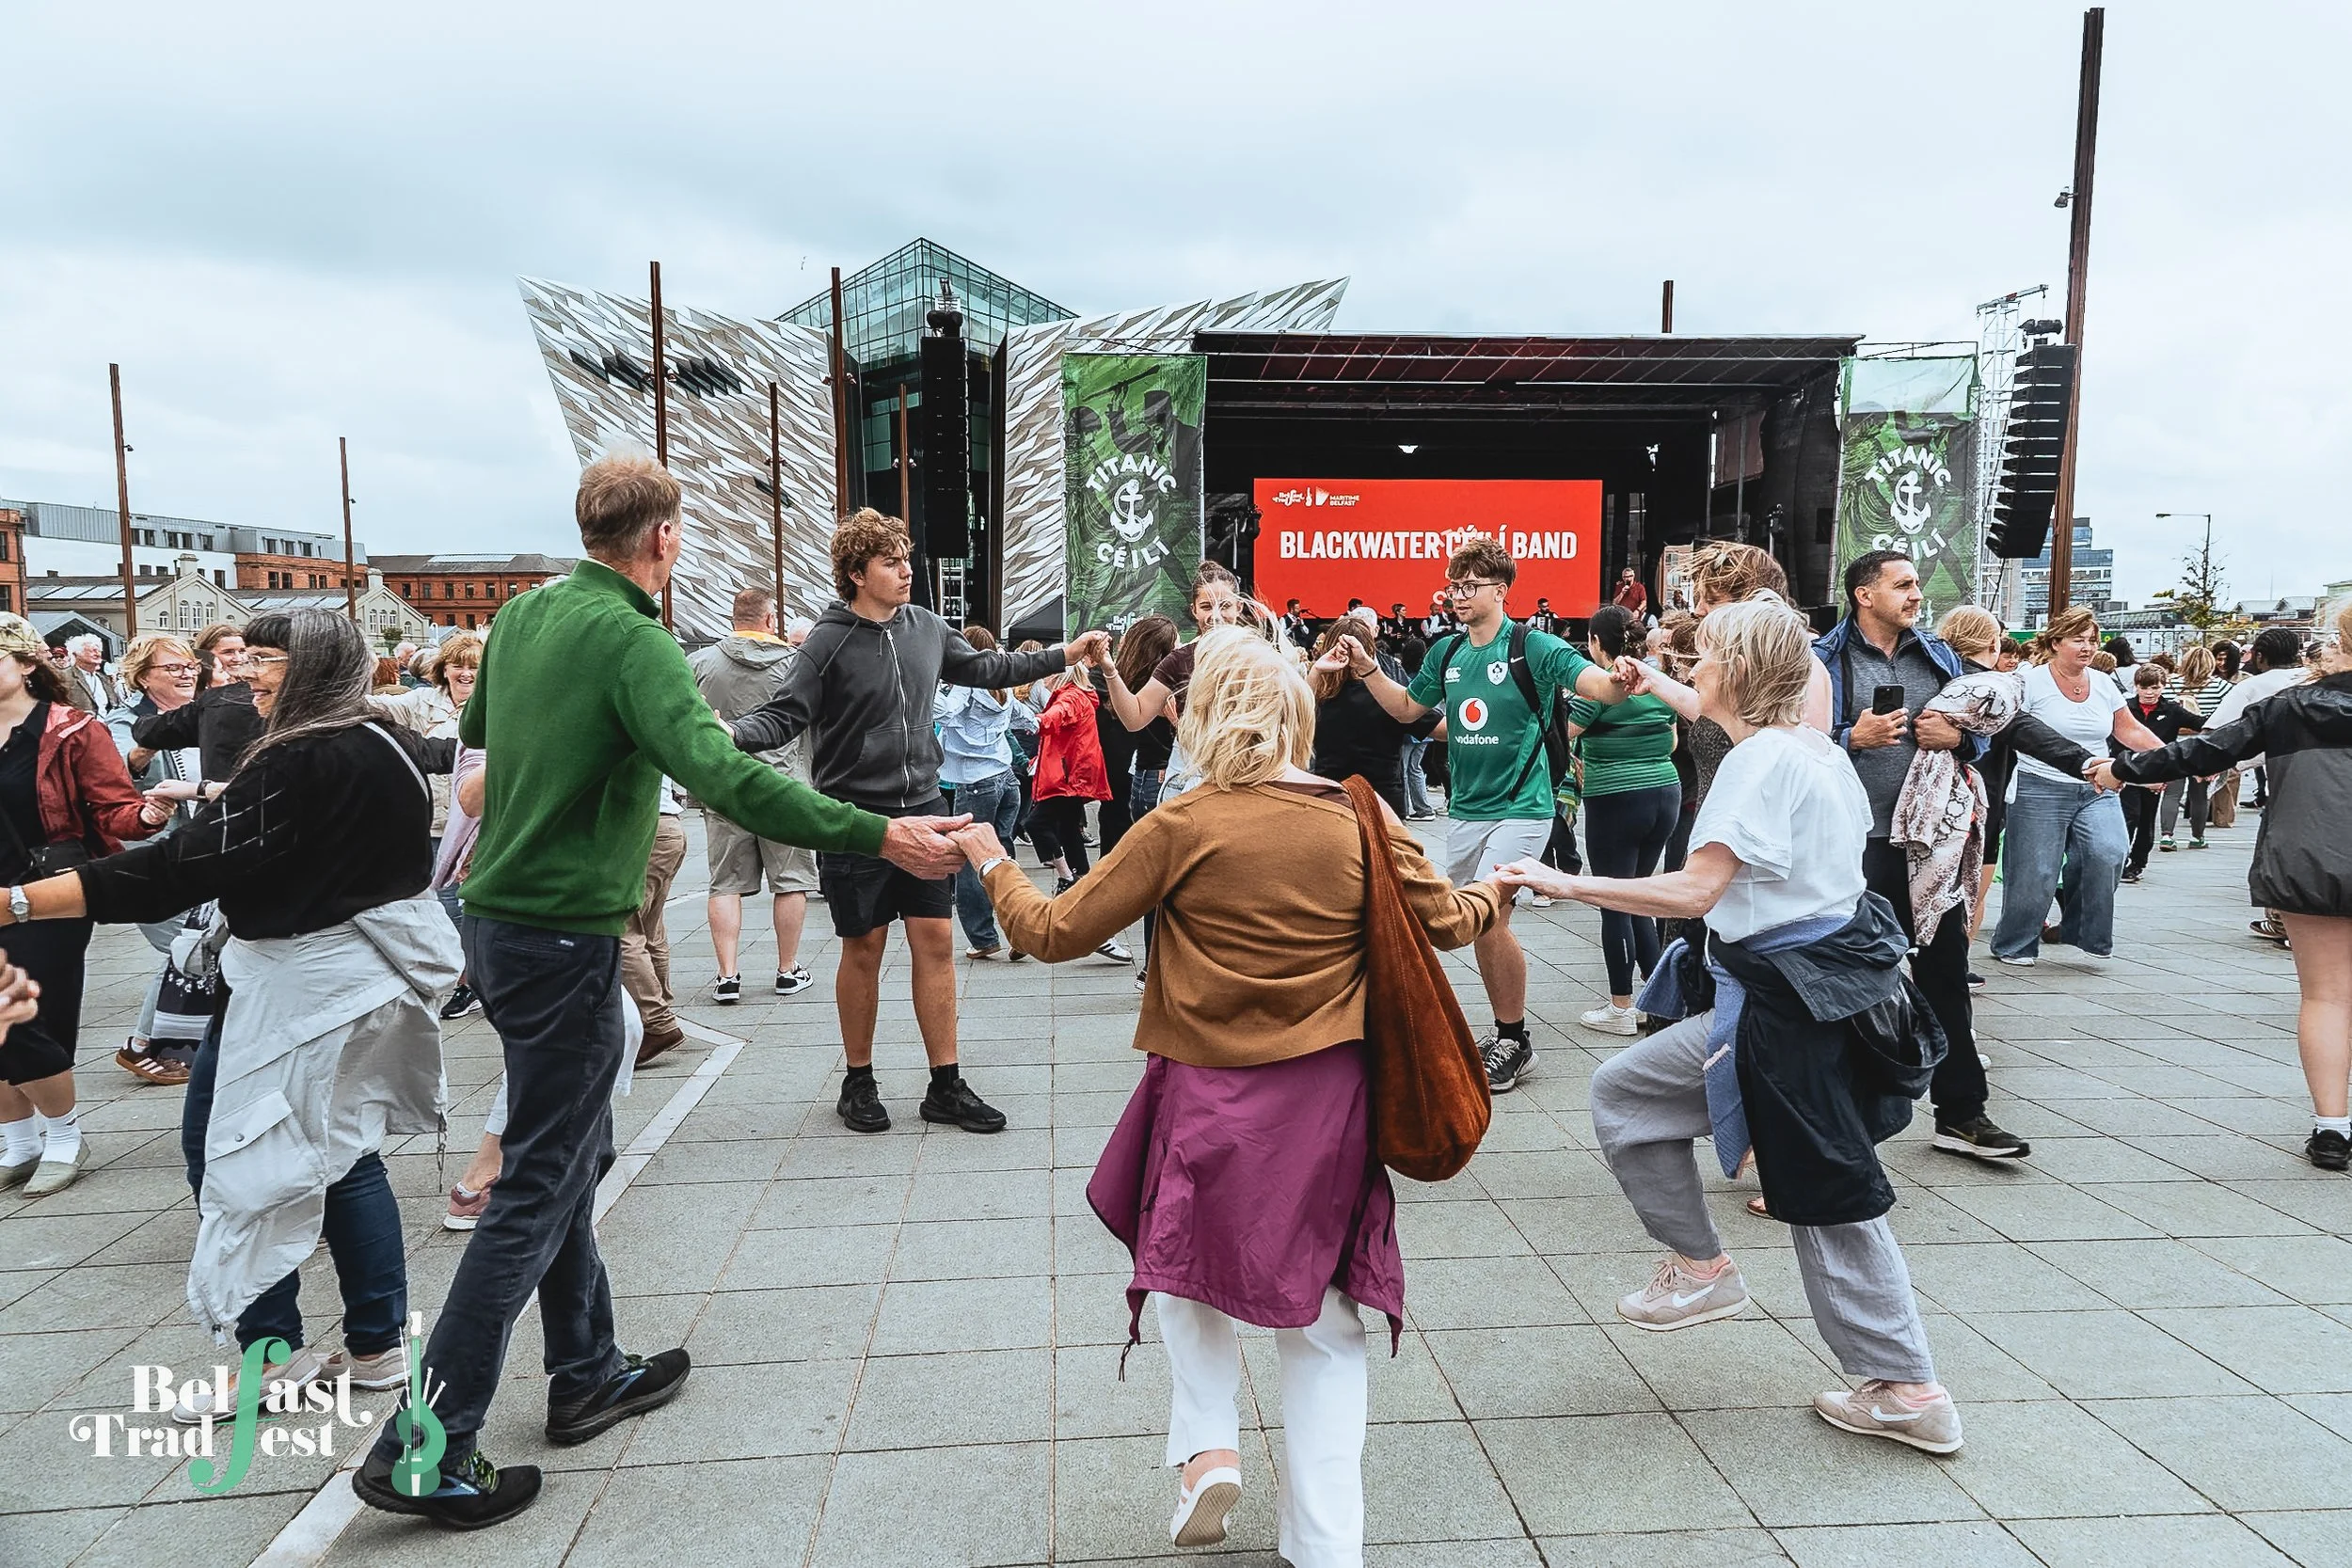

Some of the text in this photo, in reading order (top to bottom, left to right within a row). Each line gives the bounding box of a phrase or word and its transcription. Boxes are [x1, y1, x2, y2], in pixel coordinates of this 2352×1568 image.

[1085, 453, 1177, 493] TITANIC
[1863, 445, 1951, 486] TITANIC
[1097, 535, 1170, 569] CÉILÍ
[1279, 524, 1578, 559] BLACKWATER CÉÍ BAND
[1872, 528, 1947, 562] CÉILÍ
